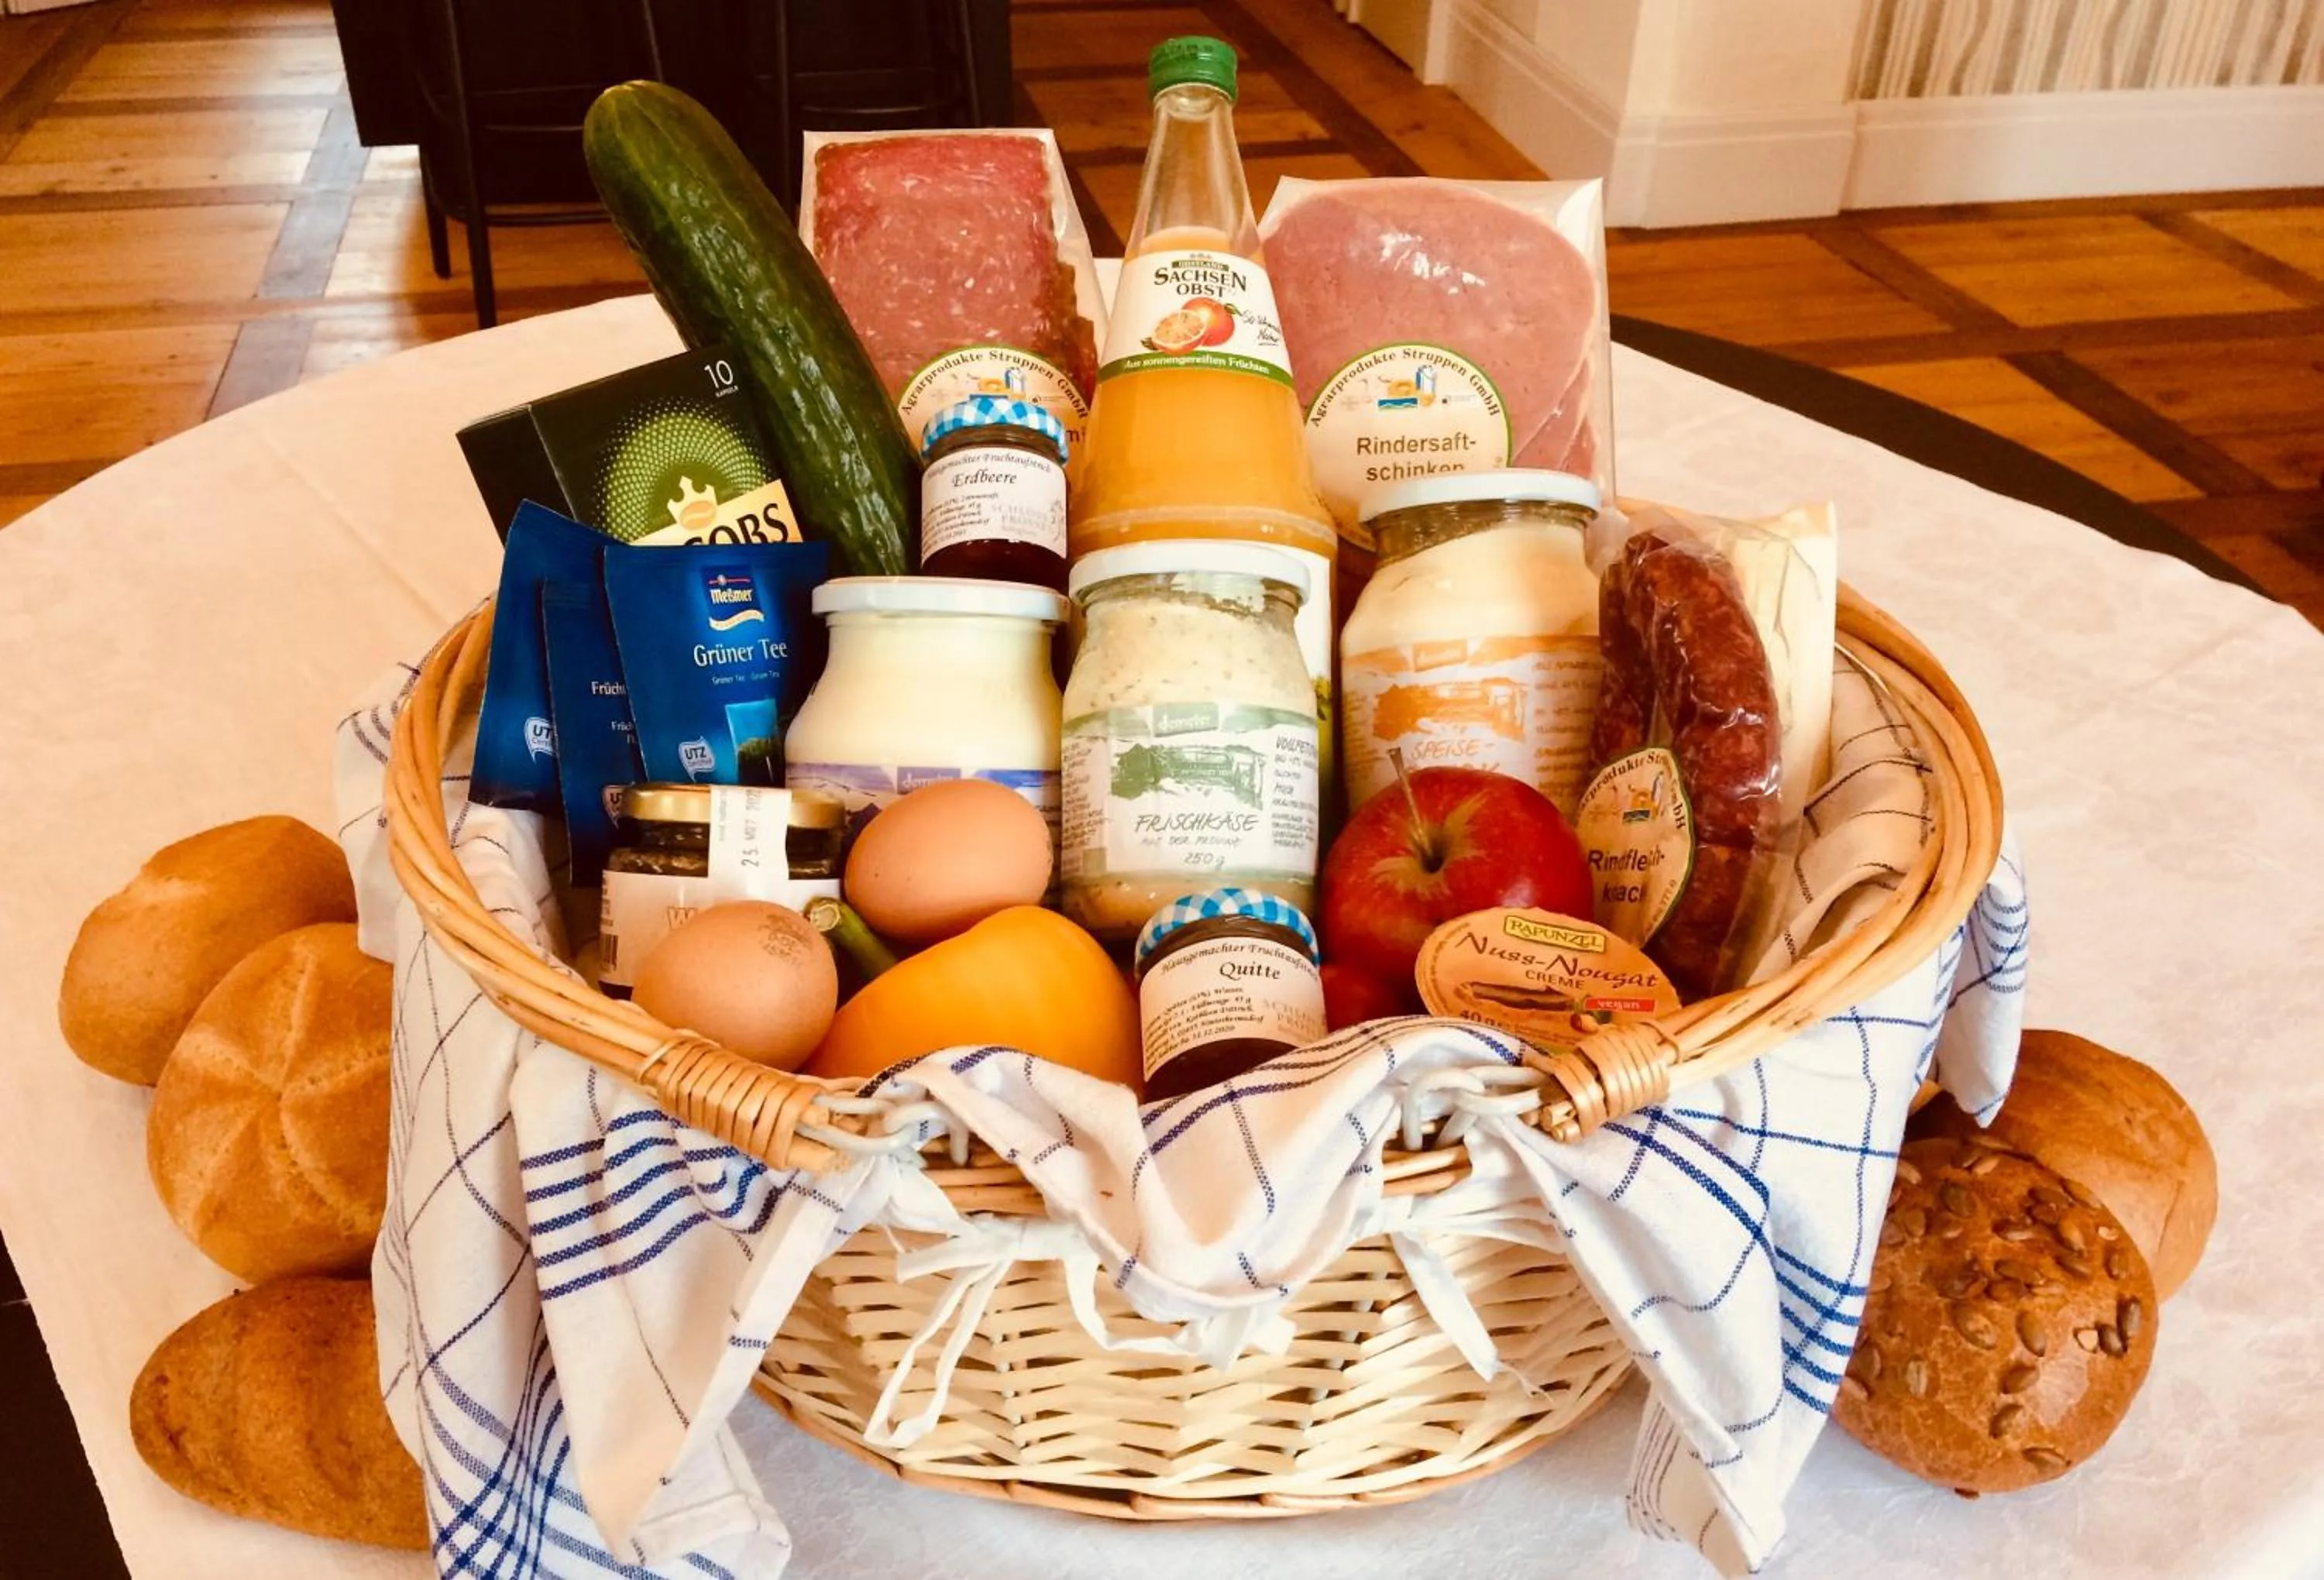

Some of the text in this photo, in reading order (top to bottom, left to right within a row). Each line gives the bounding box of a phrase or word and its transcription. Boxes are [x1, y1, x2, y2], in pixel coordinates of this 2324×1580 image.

[1154, 267, 1246, 292] SACHSEN
[1176, 282, 1224, 298] OBST
[703, 360, 734, 390] 10
[901, 351, 984, 416] Agrarprodukte
[988, 349, 1054, 380] Struppen
[1310, 348, 1501, 427] Agrarprodukte Struppen GmbH
[1356, 431, 1477, 456] Rindersaft-
[951, 467, 1018, 487] Erdbeere
[685, 503, 789, 545] OBS
[693, 637, 789, 667] Grüner Tee
[532, 723, 553, 739] UT
[685, 746, 707, 761] UTZ
[1135, 811, 1261, 834] FRISCHKÄSE
[1184, 852, 1214, 864] 250
[1511, 919, 1604, 949] RAPUNZEL
[1161, 944, 1246, 974] Hausgemachter
[1219, 960, 1281, 981] Quitte
[1525, 968, 1587, 991] CREME
